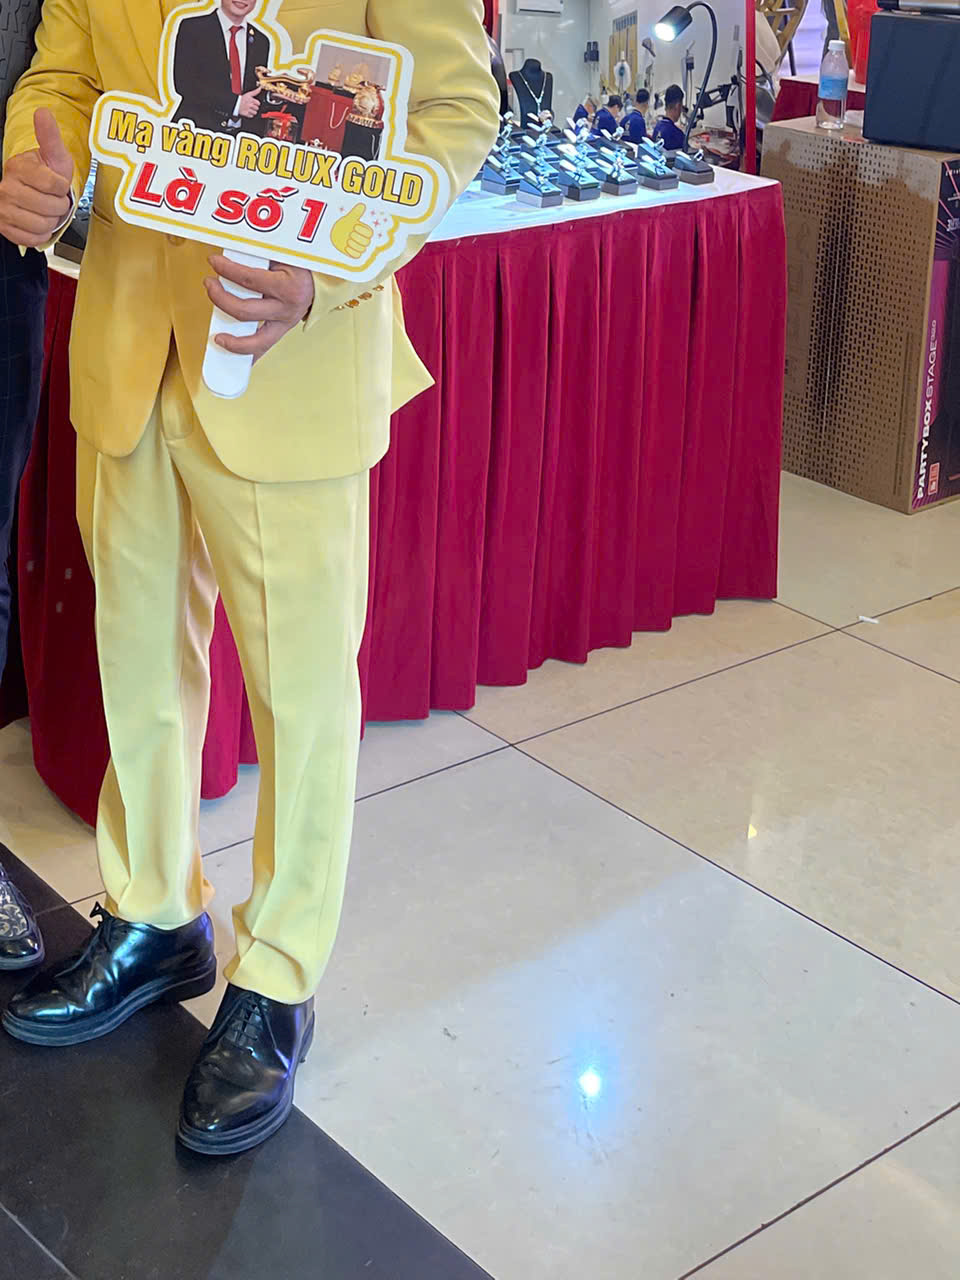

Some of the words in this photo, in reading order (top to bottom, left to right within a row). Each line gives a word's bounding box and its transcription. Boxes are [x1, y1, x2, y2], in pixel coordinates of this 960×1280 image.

[107, 108, 154, 155] Mạ
[161, 121, 230, 168] vàng
[235, 138, 342, 189] ROLUX
[341, 160, 424, 207] GOLD
[130, 160, 206, 213] Là
[212, 185, 299, 233] số
[296, 198, 328, 244] 1
[916, 399, 932, 500] PARTYBOX
